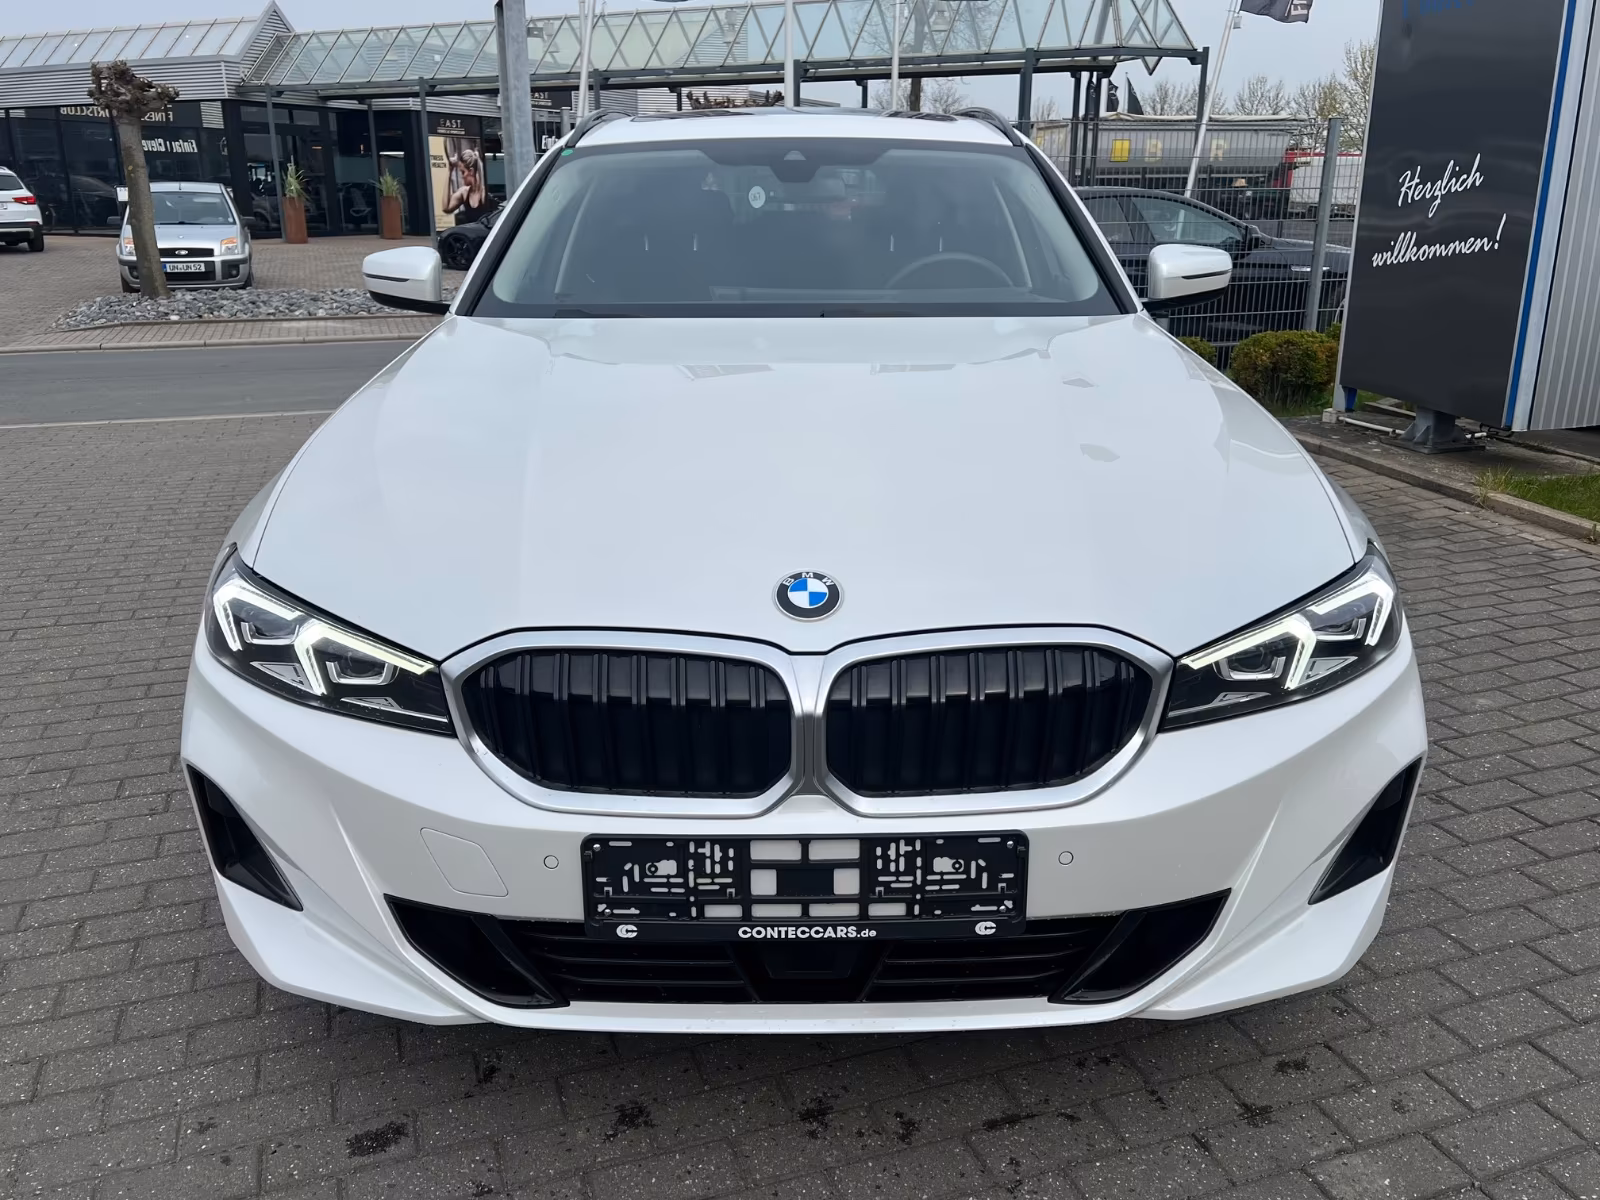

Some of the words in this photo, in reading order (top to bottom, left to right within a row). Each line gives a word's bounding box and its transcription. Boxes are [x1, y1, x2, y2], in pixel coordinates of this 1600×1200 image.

[440, 119, 461, 128] EAST
[1398, 153, 1484, 218] Herzlich
[1372, 213, 1507, 267] willkommen!
[783, 572, 834, 586] BMW
[738, 926, 877, 939] CONTECCARS.de
